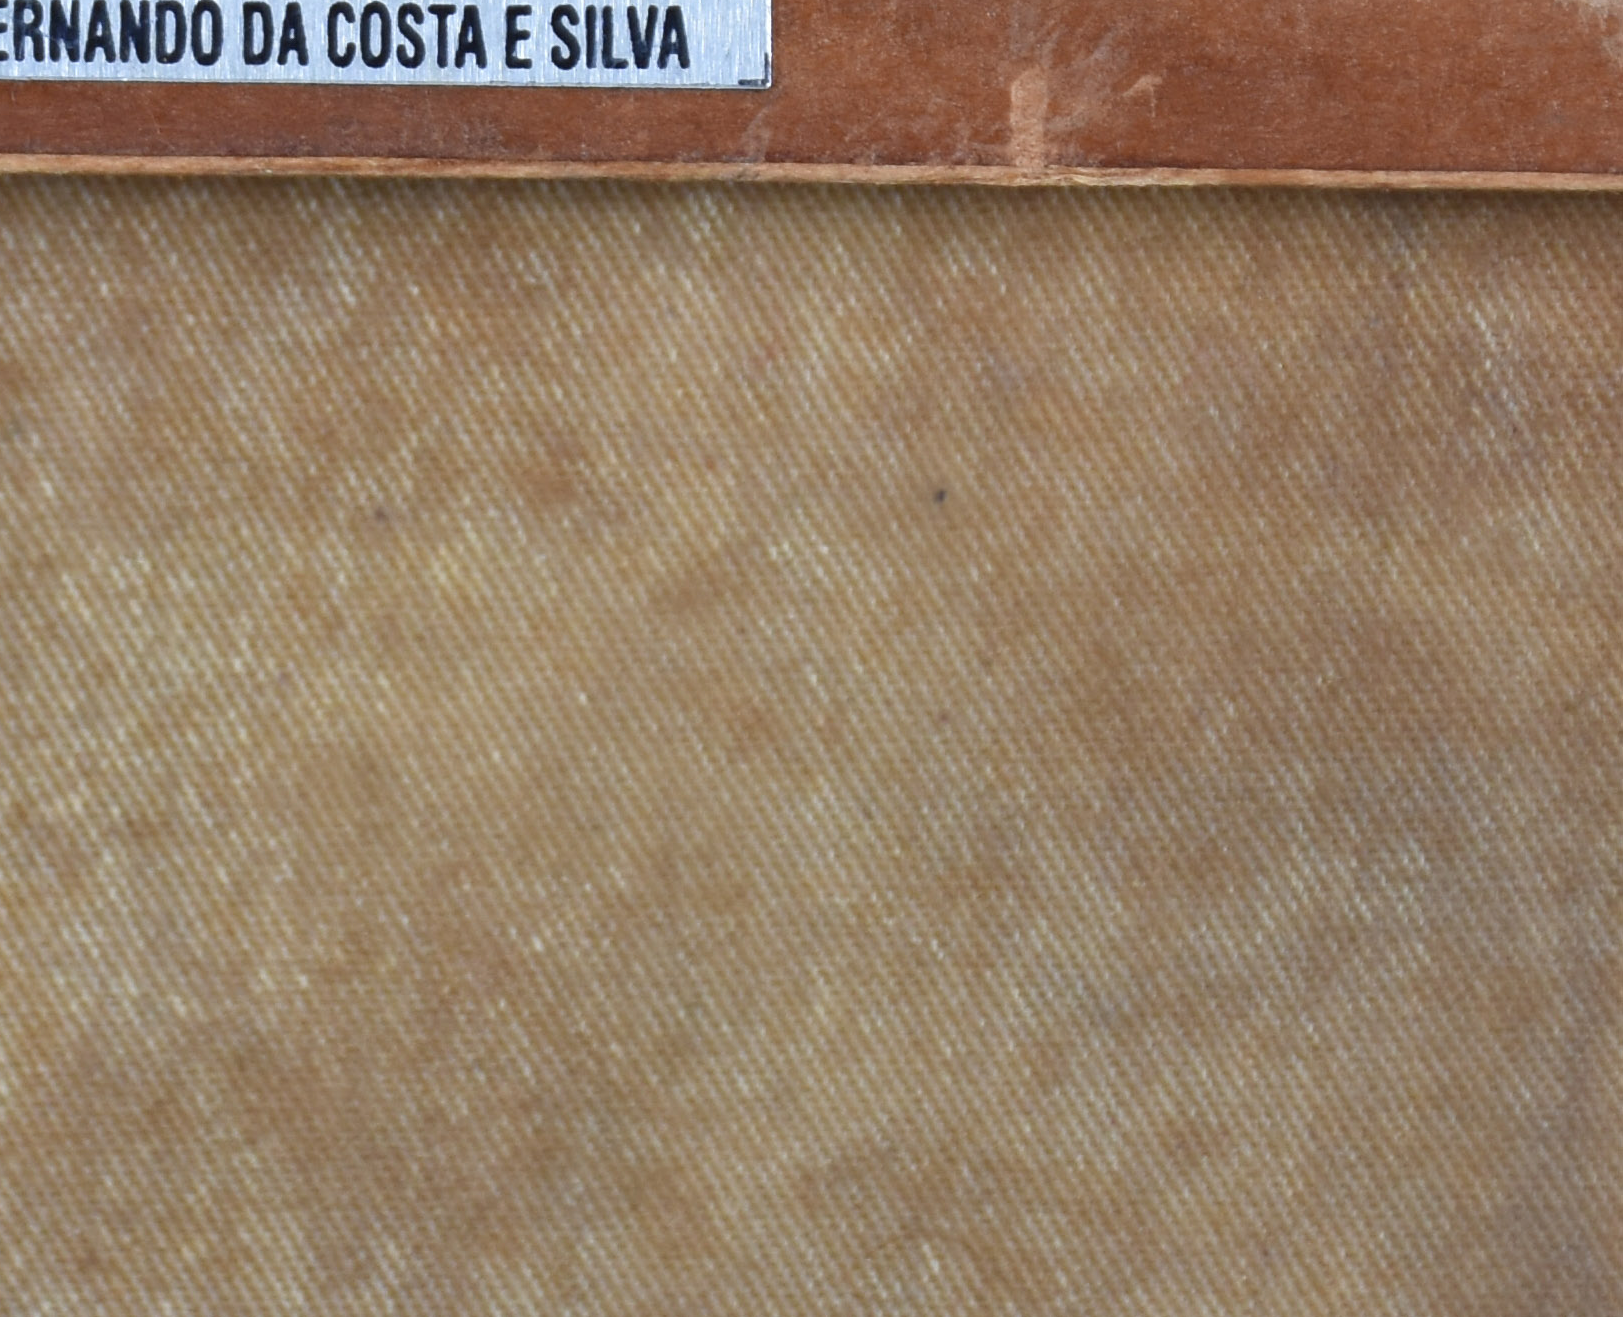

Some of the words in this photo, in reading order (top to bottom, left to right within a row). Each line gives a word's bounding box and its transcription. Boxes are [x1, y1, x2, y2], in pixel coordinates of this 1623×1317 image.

[241, 0, 310, 67] DA
[326, 0, 488, 70] COSTA
[504, 4, 533, 70] E
[549, 3, 691, 72] SILVA
